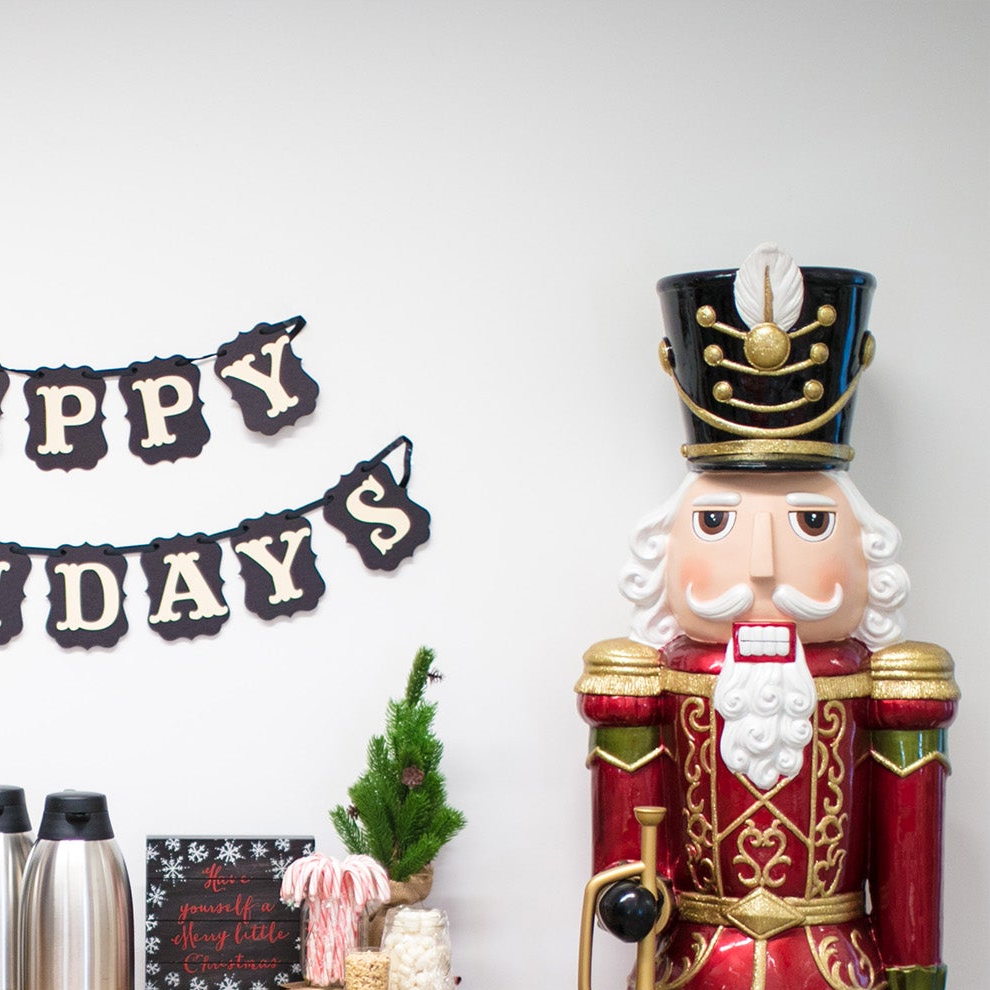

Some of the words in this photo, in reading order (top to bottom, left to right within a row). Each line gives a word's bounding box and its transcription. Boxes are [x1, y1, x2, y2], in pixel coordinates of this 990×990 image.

[201, 863, 252, 892] Have
[178, 894, 255, 924] yourself
[261, 902, 275, 912] a
[171, 921, 230, 951] Merry
[234, 921, 290, 944] little
[183, 953, 281, 974] Christmas
